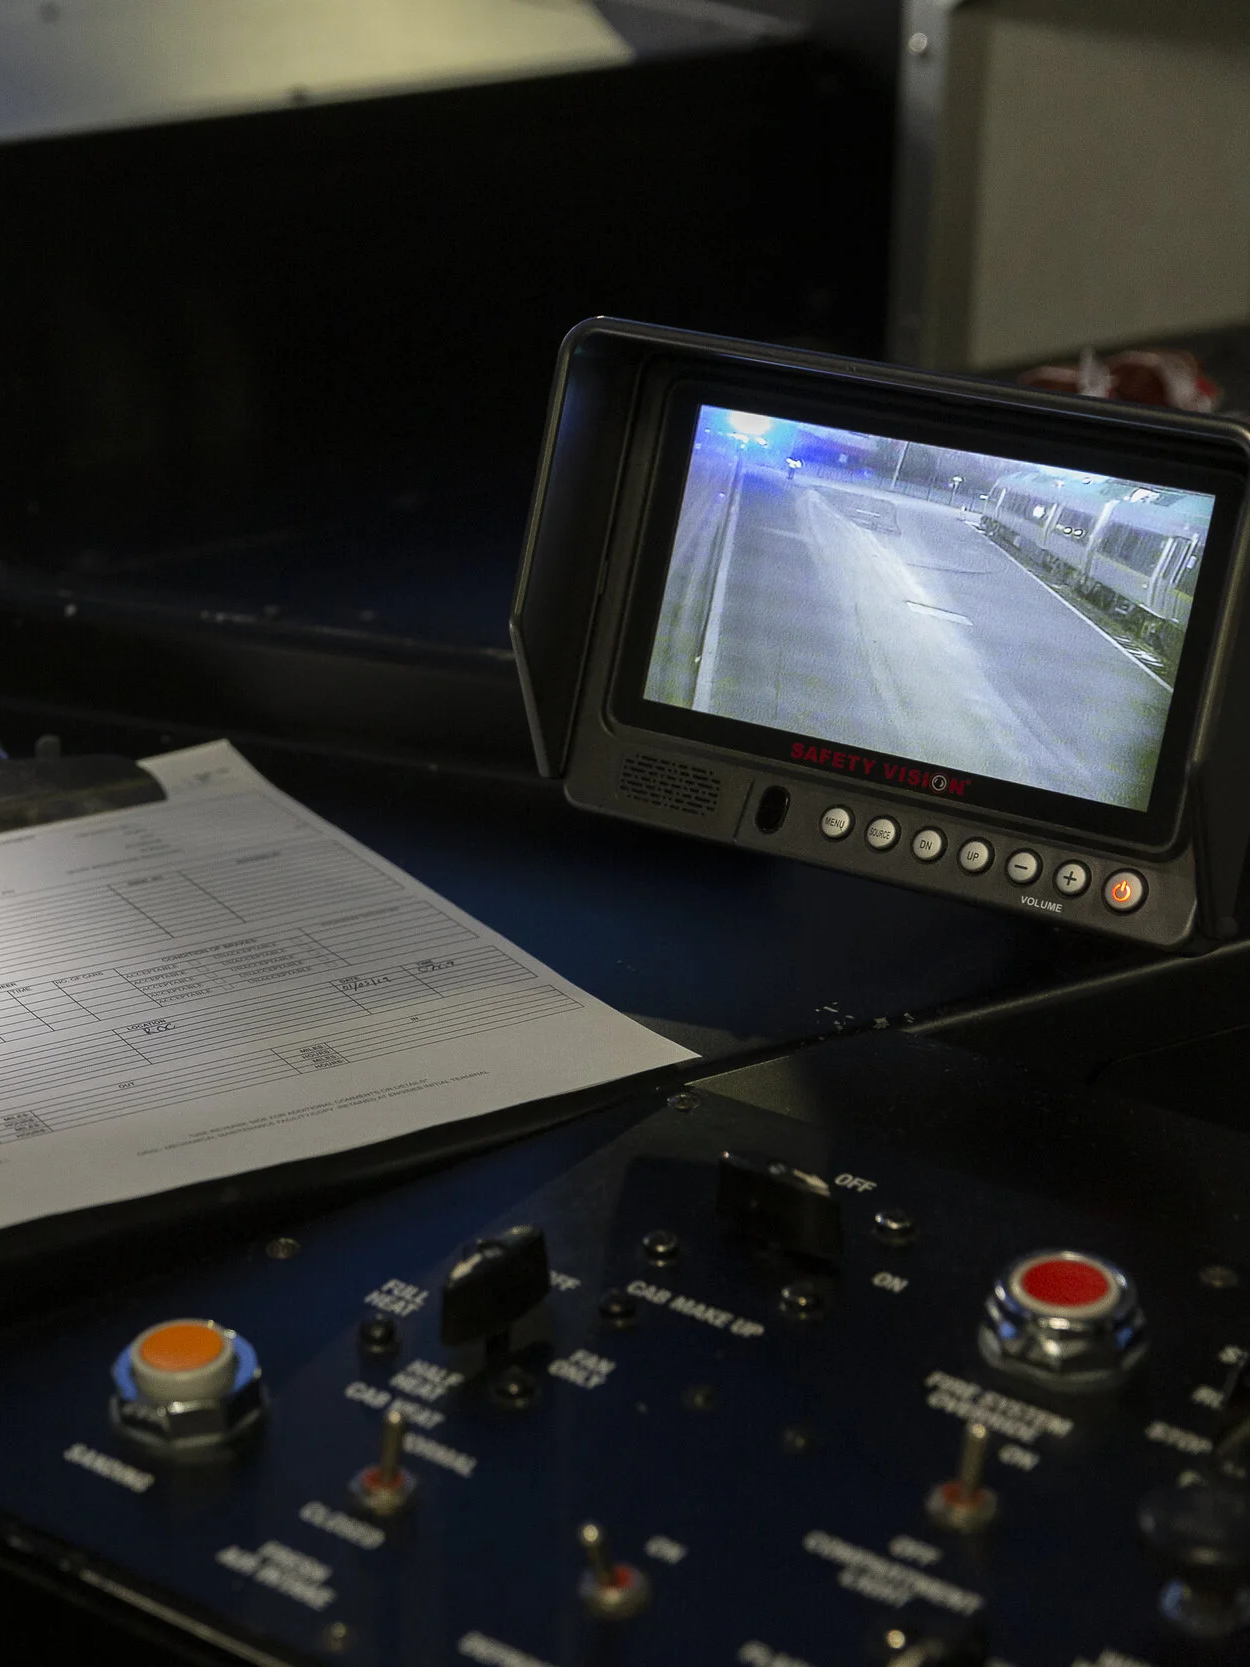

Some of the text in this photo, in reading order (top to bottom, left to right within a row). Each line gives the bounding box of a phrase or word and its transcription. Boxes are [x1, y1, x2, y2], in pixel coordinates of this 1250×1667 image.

[791, 741, 967, 797] SAFETY VISION
[824, 816, 846, 830] MENU
[868, 826, 892, 841] SOURCE
[918, 838, 933, 851] DN
[965, 849, 980, 863] UP
[1020, 894, 1064, 914] VOLUME
[10, 985, 34, 995] TIME
[126, 1018, 167, 1031] LOCATION
[118, 1081, 135, 1089] OUT
[833, 1172, 877, 1194] OFF
[380, 1278, 430, 1301] FULL
[549, 1269, 582, 1292] FF
[871, 1270, 909, 1294] ON
[363, 1290, 427, 1318] HEAT
[668, 1294, 734, 1329] MAKE
[729, 1317, 766, 1339] UP
